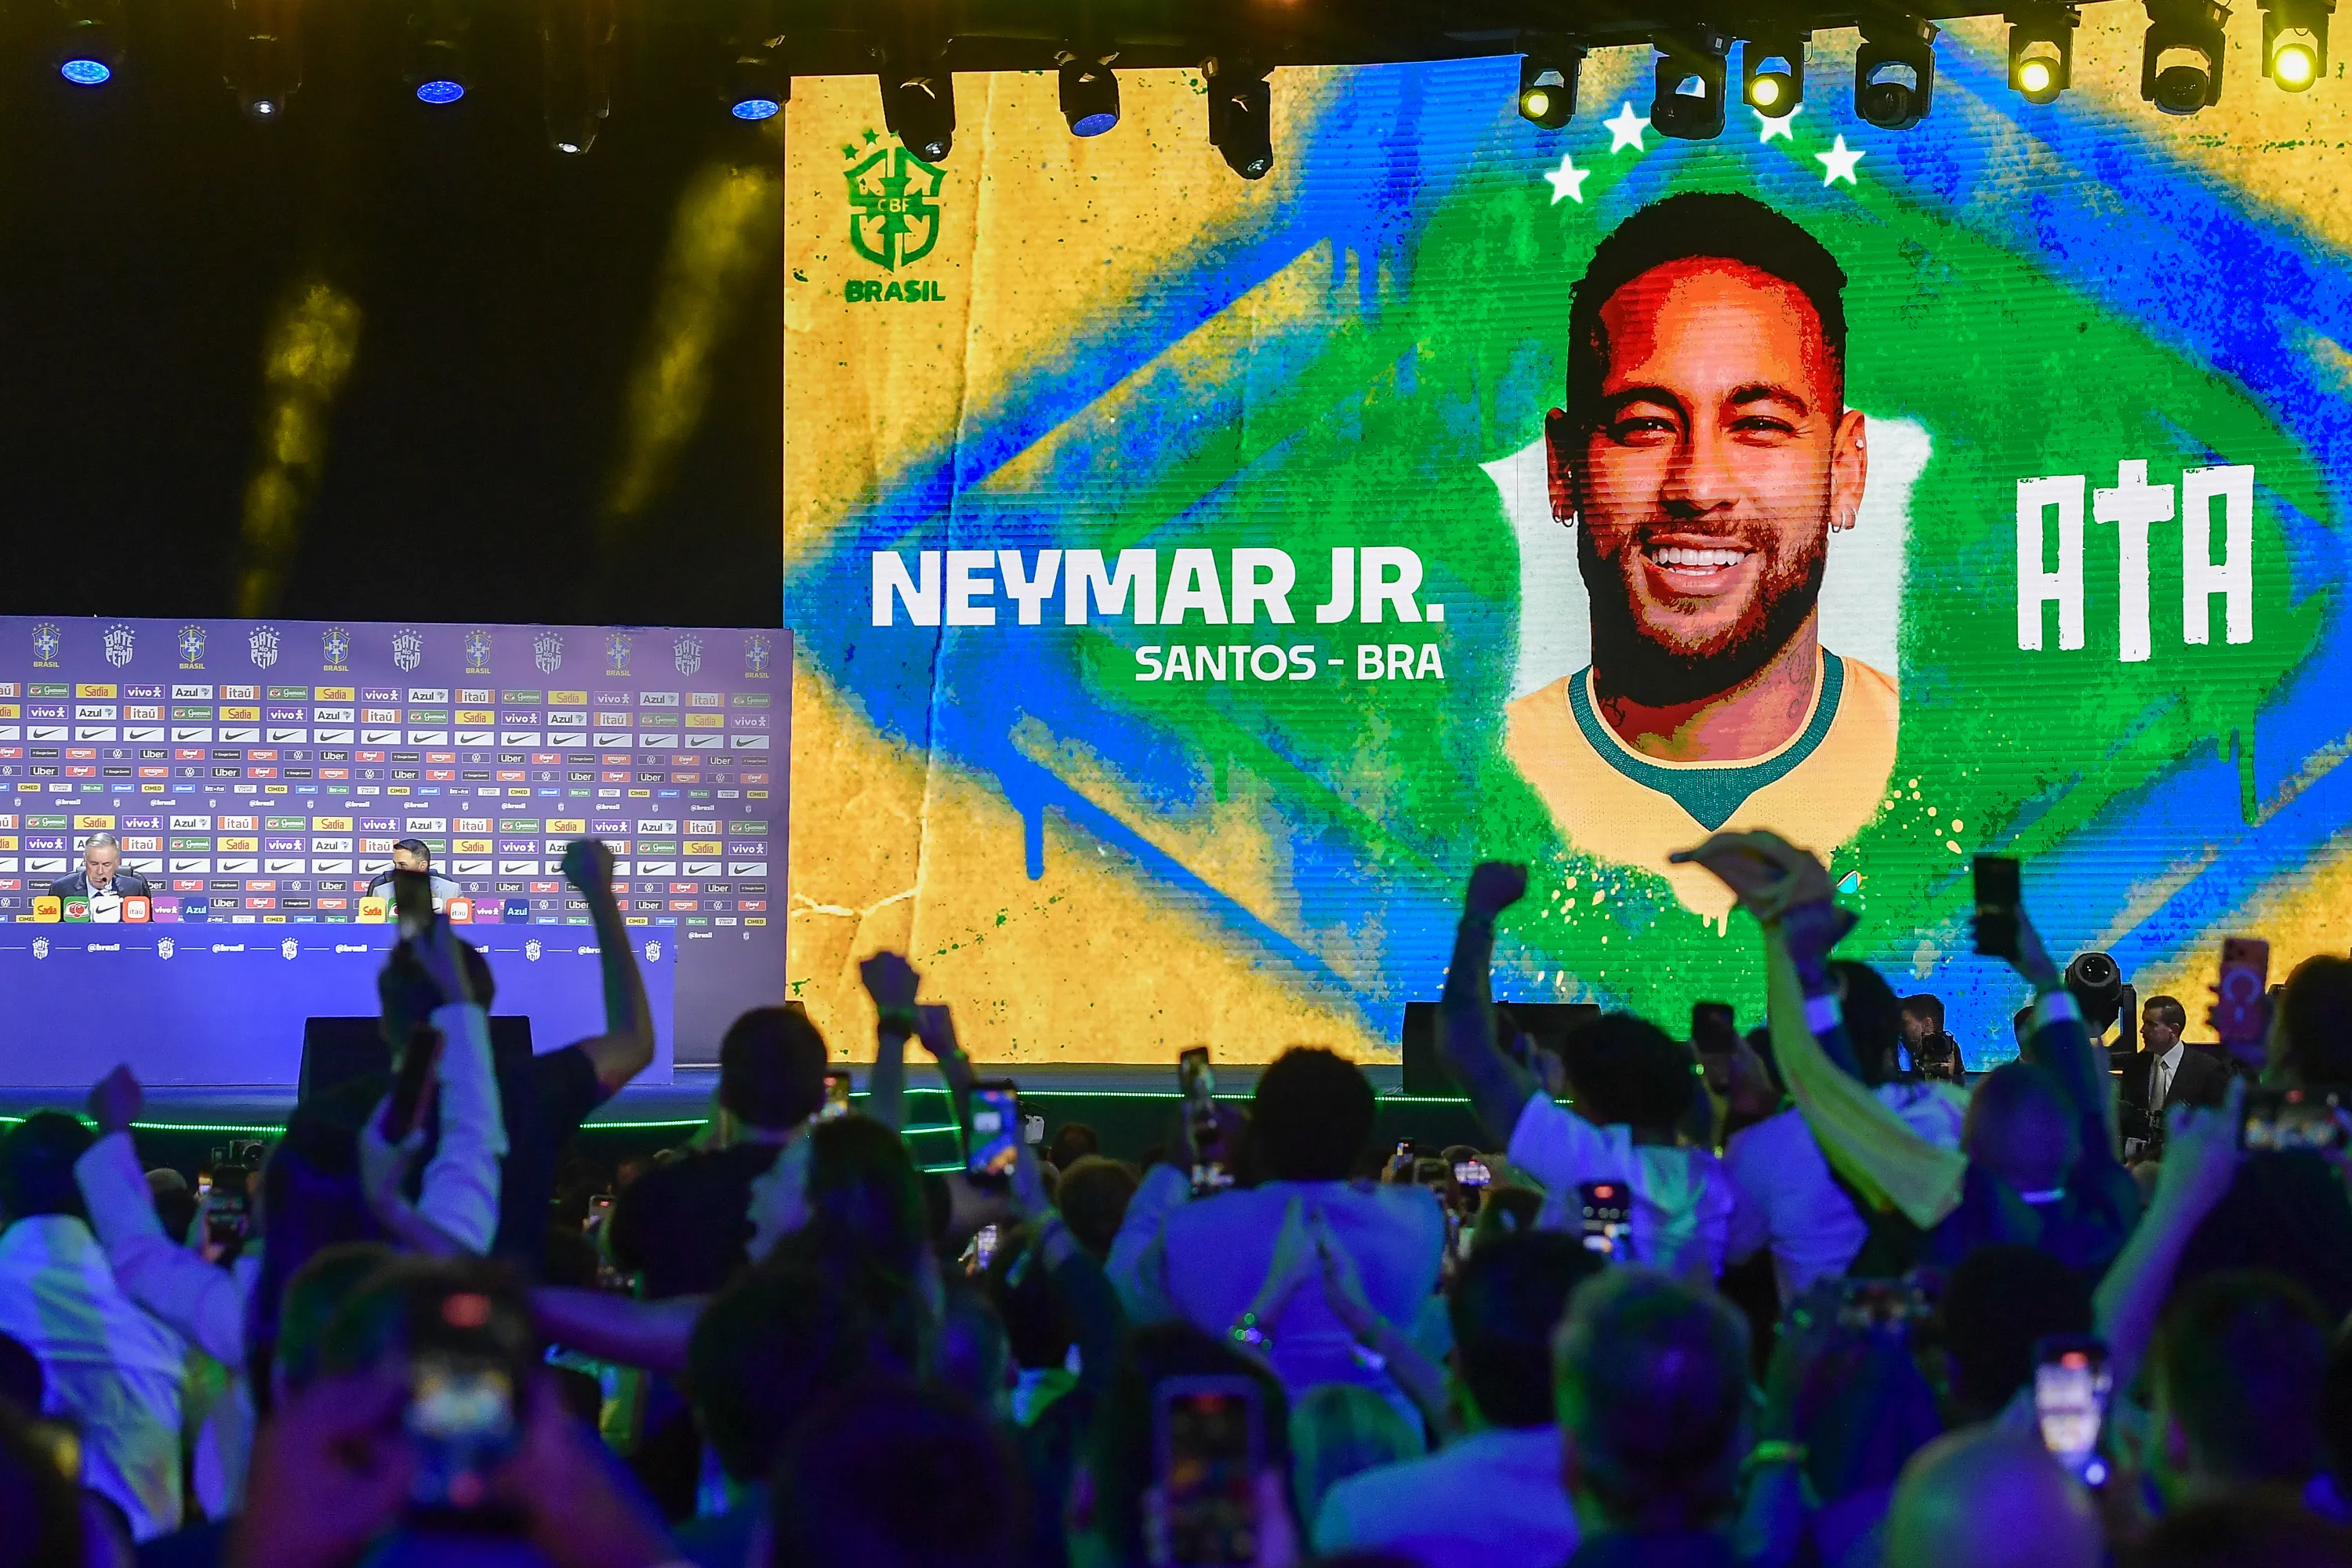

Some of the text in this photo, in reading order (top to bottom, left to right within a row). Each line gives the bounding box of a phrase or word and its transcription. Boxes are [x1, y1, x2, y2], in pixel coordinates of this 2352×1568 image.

[878, 198, 910, 212] CBF
[845, 280, 946, 303] BRASIL
[2016, 459, 2256, 662] ATA
[872, 546, 1445, 626] NEYMAR JR.
[103, 630, 136, 648] BATE
[249, 632, 281, 648] BATE
[392, 635, 423, 652] BATE
[533, 637, 564, 655] BATE
[673, 641, 703, 656] BATE
[1134, 644, 1316, 682] SANTOS
[1358, 644, 1445, 681] BRA
[85, 686, 108, 696] Sadia
[128, 688, 151, 696] vivo
[230, 688, 251, 698] itaú
[324, 689, 346, 699] Sadia
[365, 691, 388, 700] vivo
[465, 691, 485, 702] itaú
[557, 692, 579, 703] Sadia
[598, 695, 620, 703] vivo
[695, 695, 716, 705] itaú
[31, 708, 54, 717] vivo
[133, 709, 154, 718] itaú
[228, 709, 251, 719] Sadia
[270, 710, 294, 719] vivo
[318, 711, 339, 720] Azul
[371, 711, 391, 721] itaú
[463, 713, 485, 723] Sadia
[551, 715, 572, 724] Azul
[603, 715, 623, 724] itaú
[694, 716, 716, 726] Sadia
[83, 817, 106, 827] Sadia
[126, 818, 150, 827] vivo
[227, 818, 249, 828] itaú
[321, 819, 344, 829] Sadia
[363, 821, 387, 829] vivo
[410, 821, 431, 829] Azul
[463, 820, 484, 830] itaú
[554, 821, 576, 831] Sadia
[595, 822, 618, 831] vivo
[692, 822, 713, 832] itaú
[29, 839, 53, 848] vivo
[132, 839, 153, 849] itaú
[227, 839, 249, 849] Sadia
[269, 840, 292, 849] vivo
[316, 841, 337, 850] Azul
[369, 841, 390, 851] itaú
[462, 841, 484, 851] Sadia
[503, 842, 526, 851] vivo
[691, 843, 713, 854] Sadia
[732, 844, 754, 853] vivo
[38, 905, 56, 915] Sadia
[364, 906, 382, 916] Sadia
[212, 944, 244, 953] @brasil
[336, 945, 368, 953] @brasil
